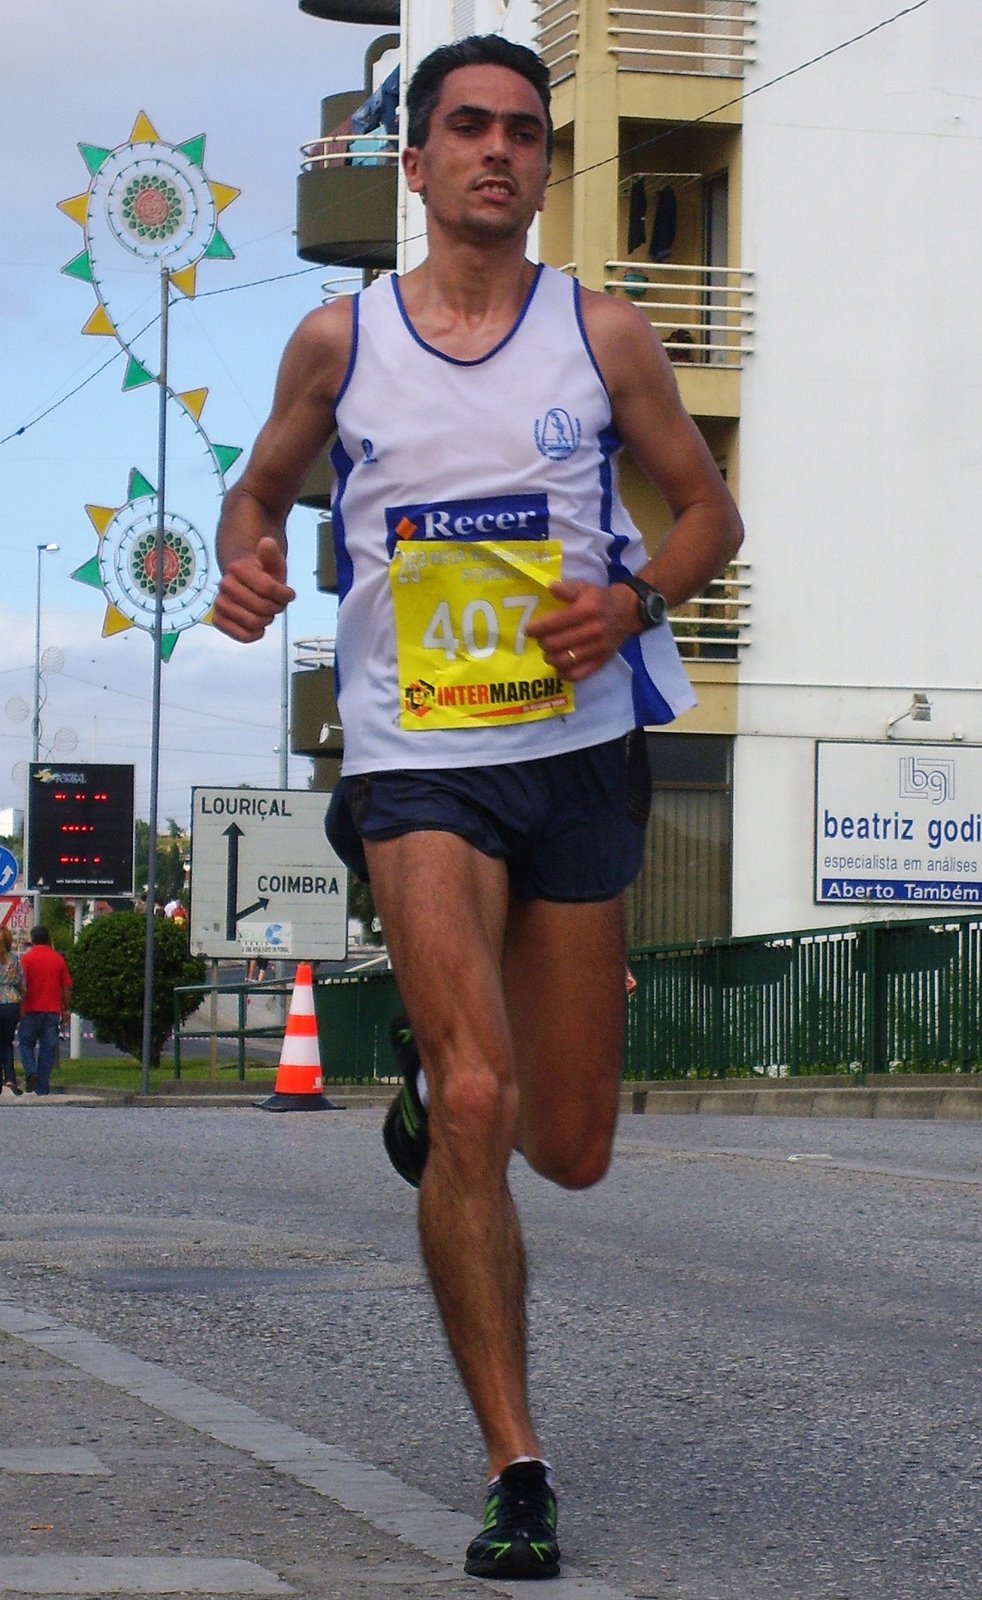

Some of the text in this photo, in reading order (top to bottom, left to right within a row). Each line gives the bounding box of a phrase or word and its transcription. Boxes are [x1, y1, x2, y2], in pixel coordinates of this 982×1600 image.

[423, 510, 536, 539] Recer
[422, 595, 540, 661] 407
[201, 797, 292, 821] LOURIÇAL
[824, 809, 982, 849] beatriz godi
[824, 854, 978, 873] especialista em análises
[258, 875, 339, 894] COIMBRA
[827, 881, 979, 900] Aberto Também
